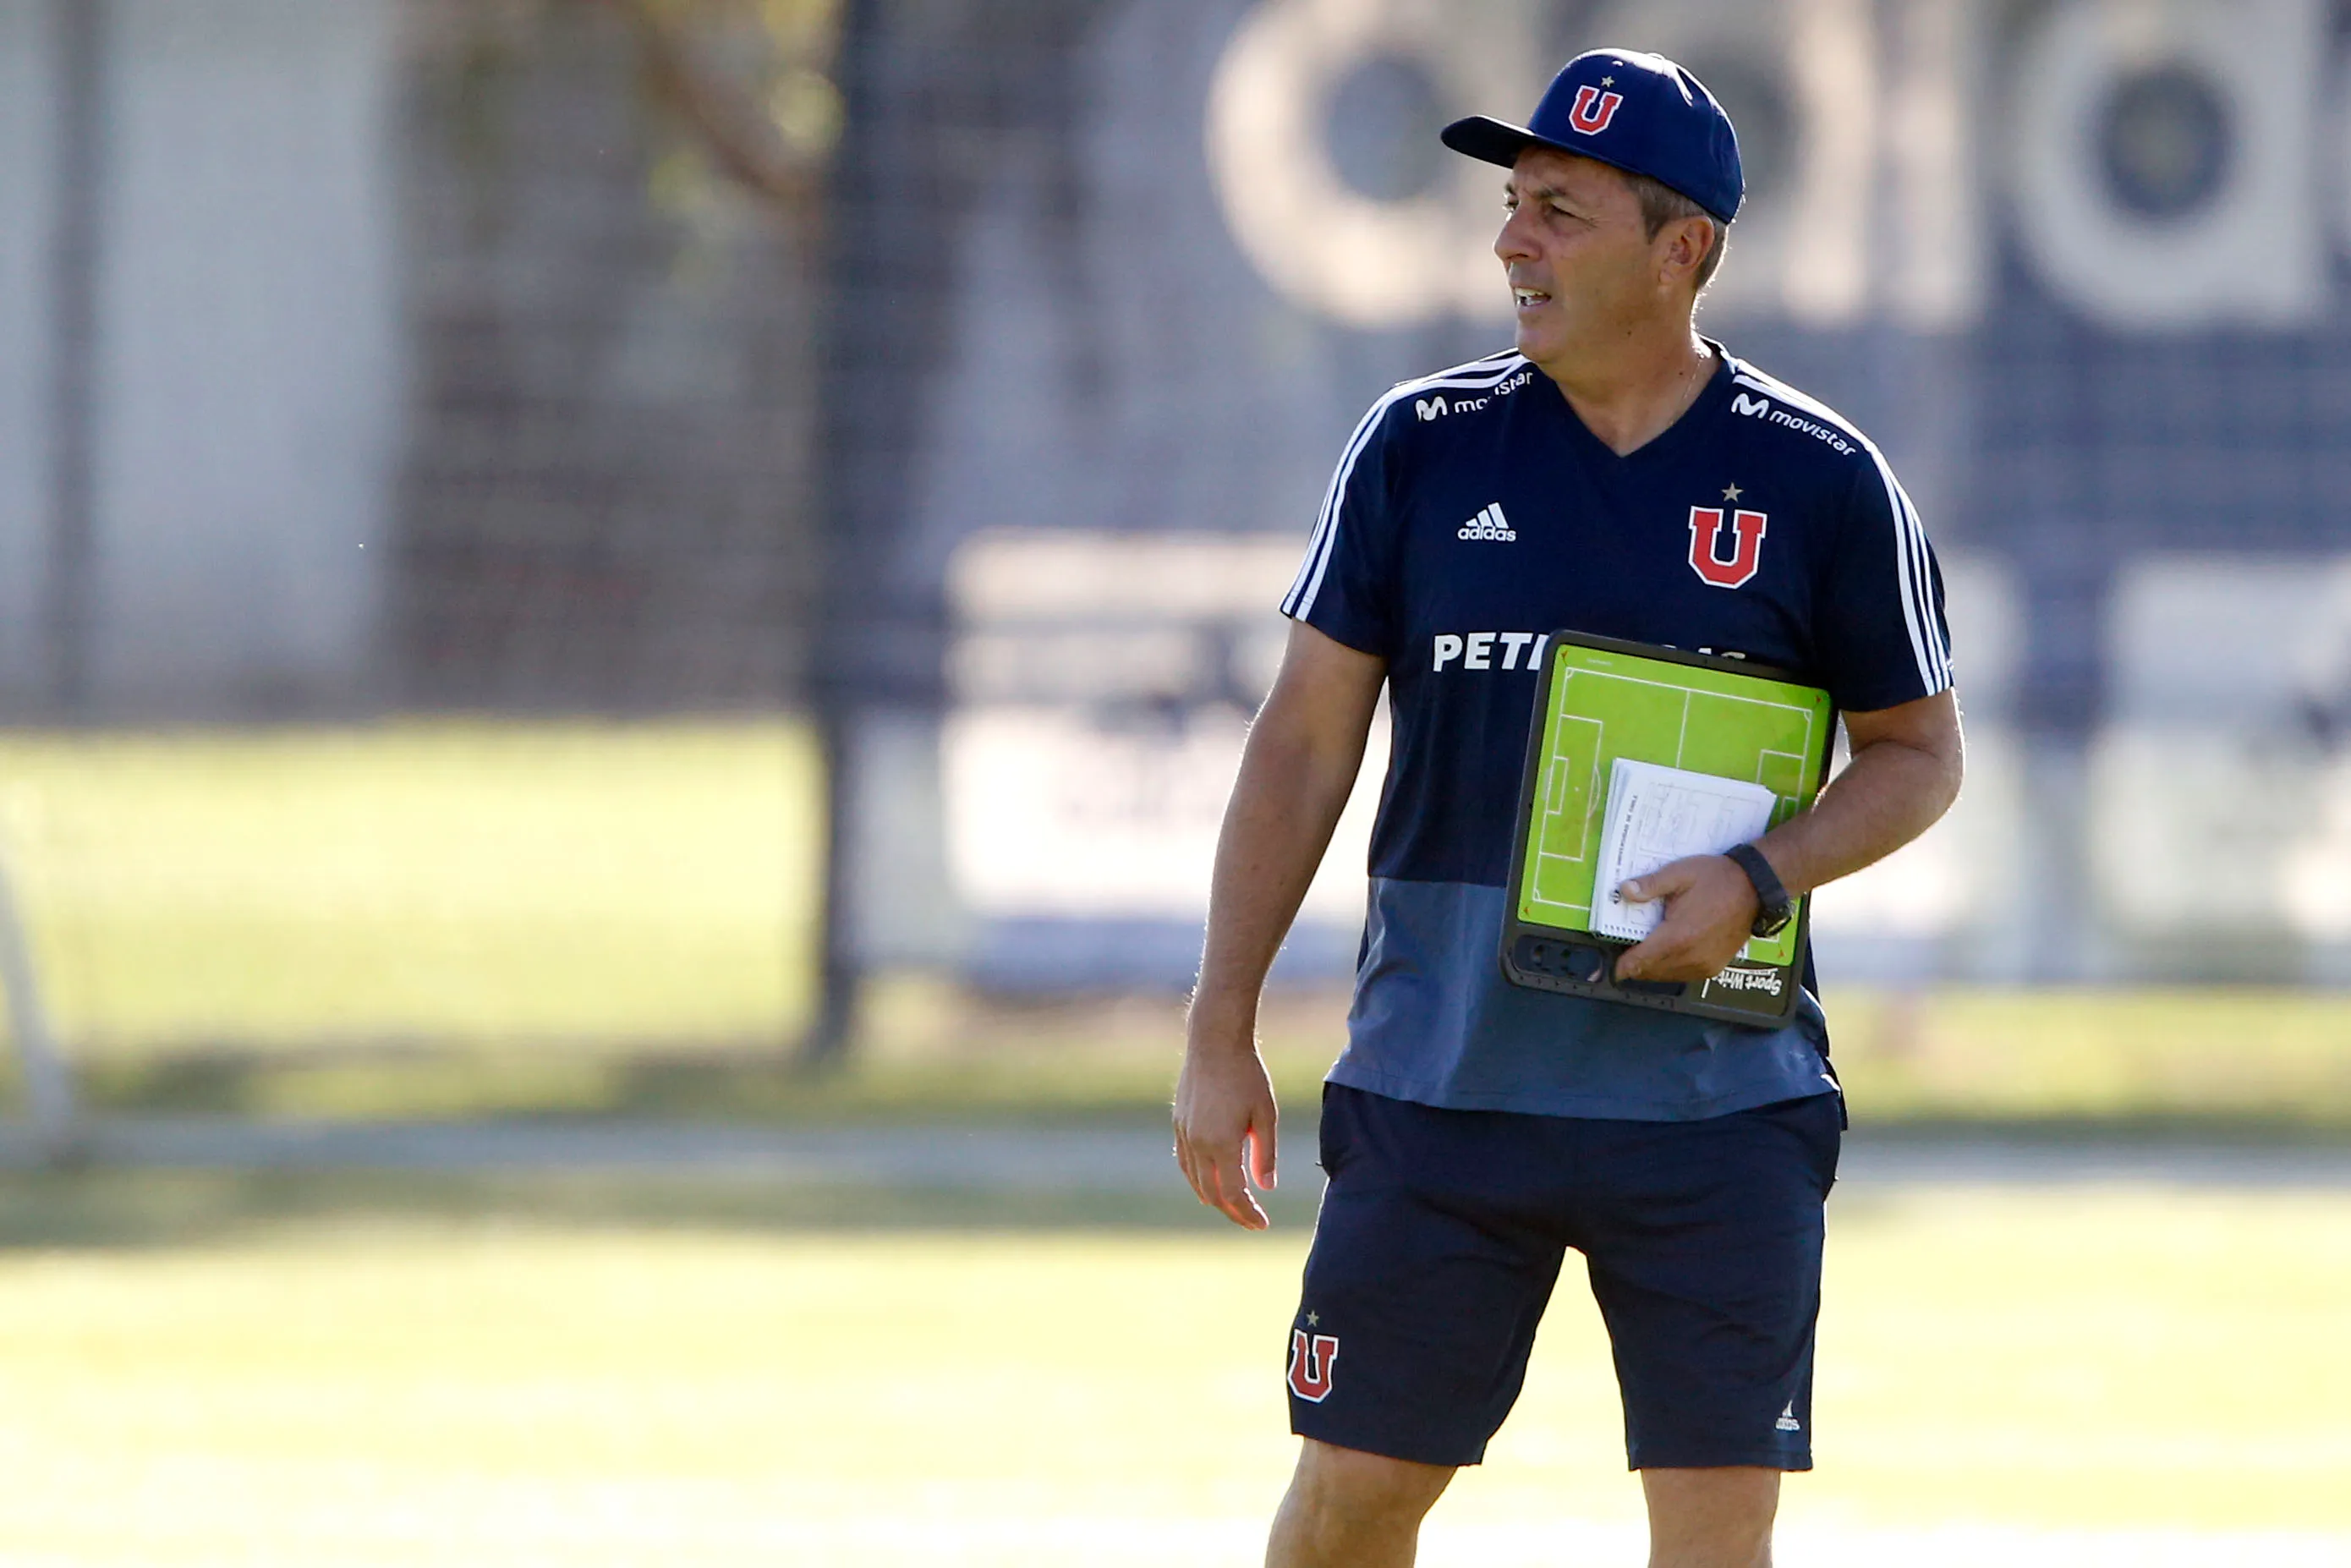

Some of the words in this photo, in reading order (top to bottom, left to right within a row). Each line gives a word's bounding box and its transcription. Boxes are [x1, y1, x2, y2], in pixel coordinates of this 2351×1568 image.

[1569, 85, 1624, 135] U
[1454, 372, 1532, 414] moistar
[1769, 410, 1856, 456] movistar
[1457, 525, 1516, 542] adidas
[1688, 506, 1767, 589] U
[1745, 972, 1783, 996] Sport
[1287, 1328, 1339, 1403] U
